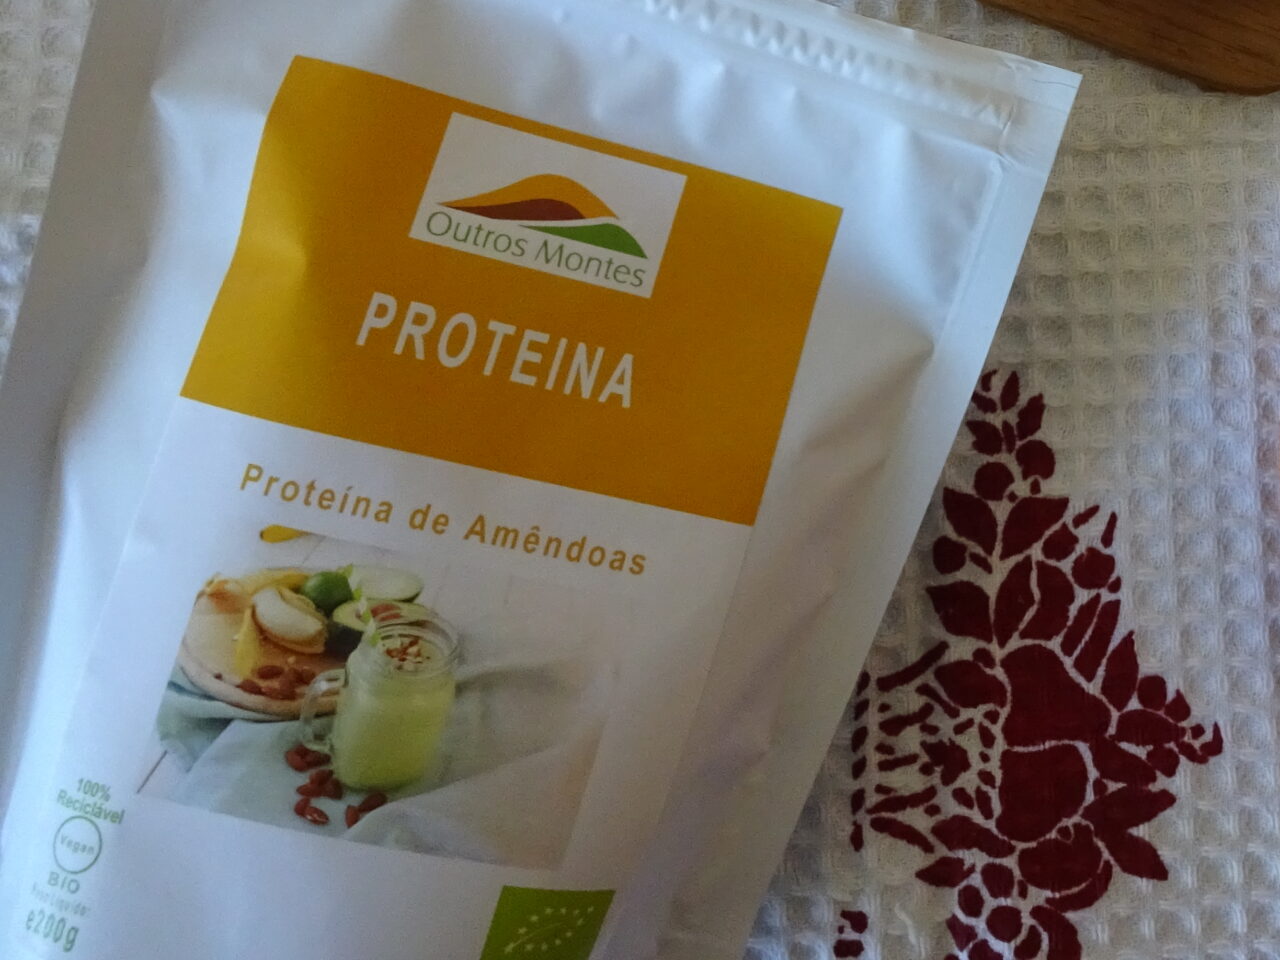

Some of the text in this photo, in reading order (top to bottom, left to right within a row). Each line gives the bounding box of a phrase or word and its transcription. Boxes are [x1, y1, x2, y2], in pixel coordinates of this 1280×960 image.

[426, 211, 646, 288] Outros Montes
[356, 291, 634, 408] PROTEINA
[240, 463, 648, 575] Proteína de Amêndoas
[56, 789, 125, 825] Reciclável
[77, 777, 111, 802] 100%
[60, 834, 95, 855] Vegan
[47, 871, 80, 894] BIO
